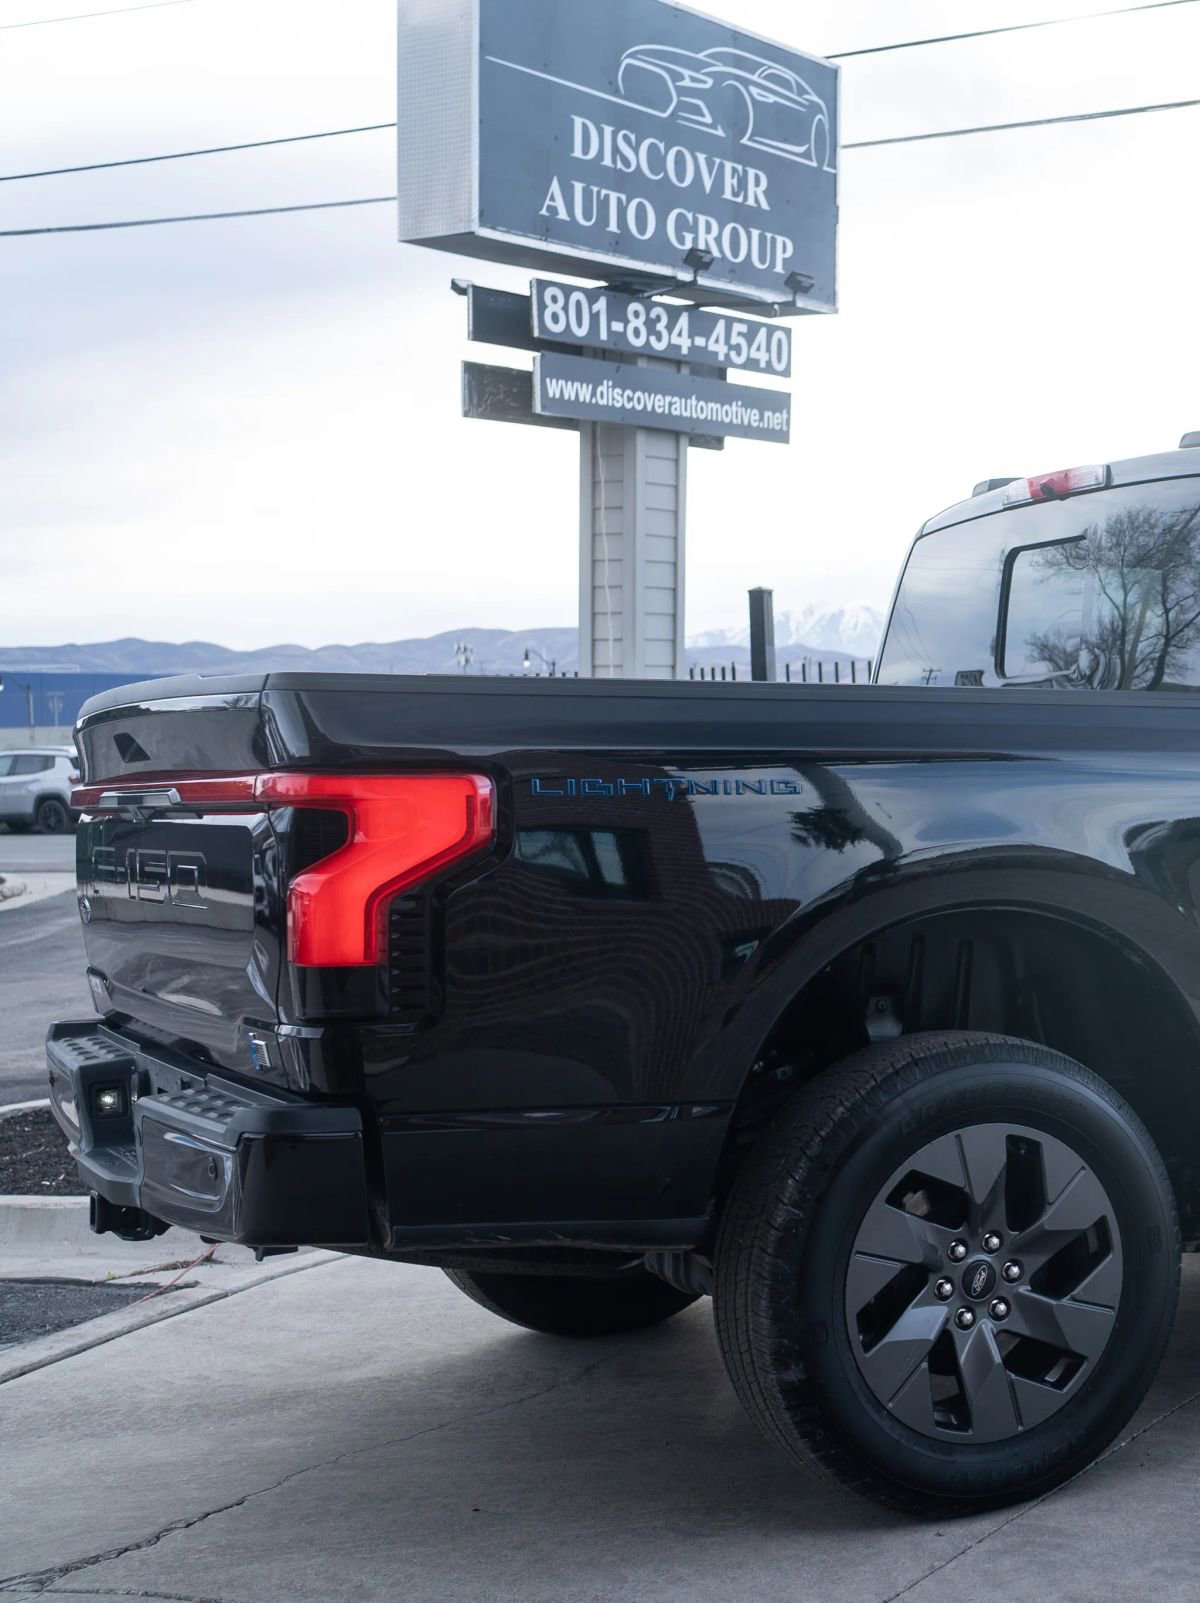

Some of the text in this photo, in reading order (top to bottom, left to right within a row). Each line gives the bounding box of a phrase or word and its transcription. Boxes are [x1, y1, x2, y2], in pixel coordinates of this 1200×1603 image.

[570, 115, 770, 210] DISCOVER
[539, 175, 794, 274] AUTO GROUP
[543, 287, 789, 372] 801-834-4540
[545, 376, 788, 431] www.discoverautomotive.net
[531, 777, 802, 801] LIGHTNING
[92, 846, 209, 910] F-150
